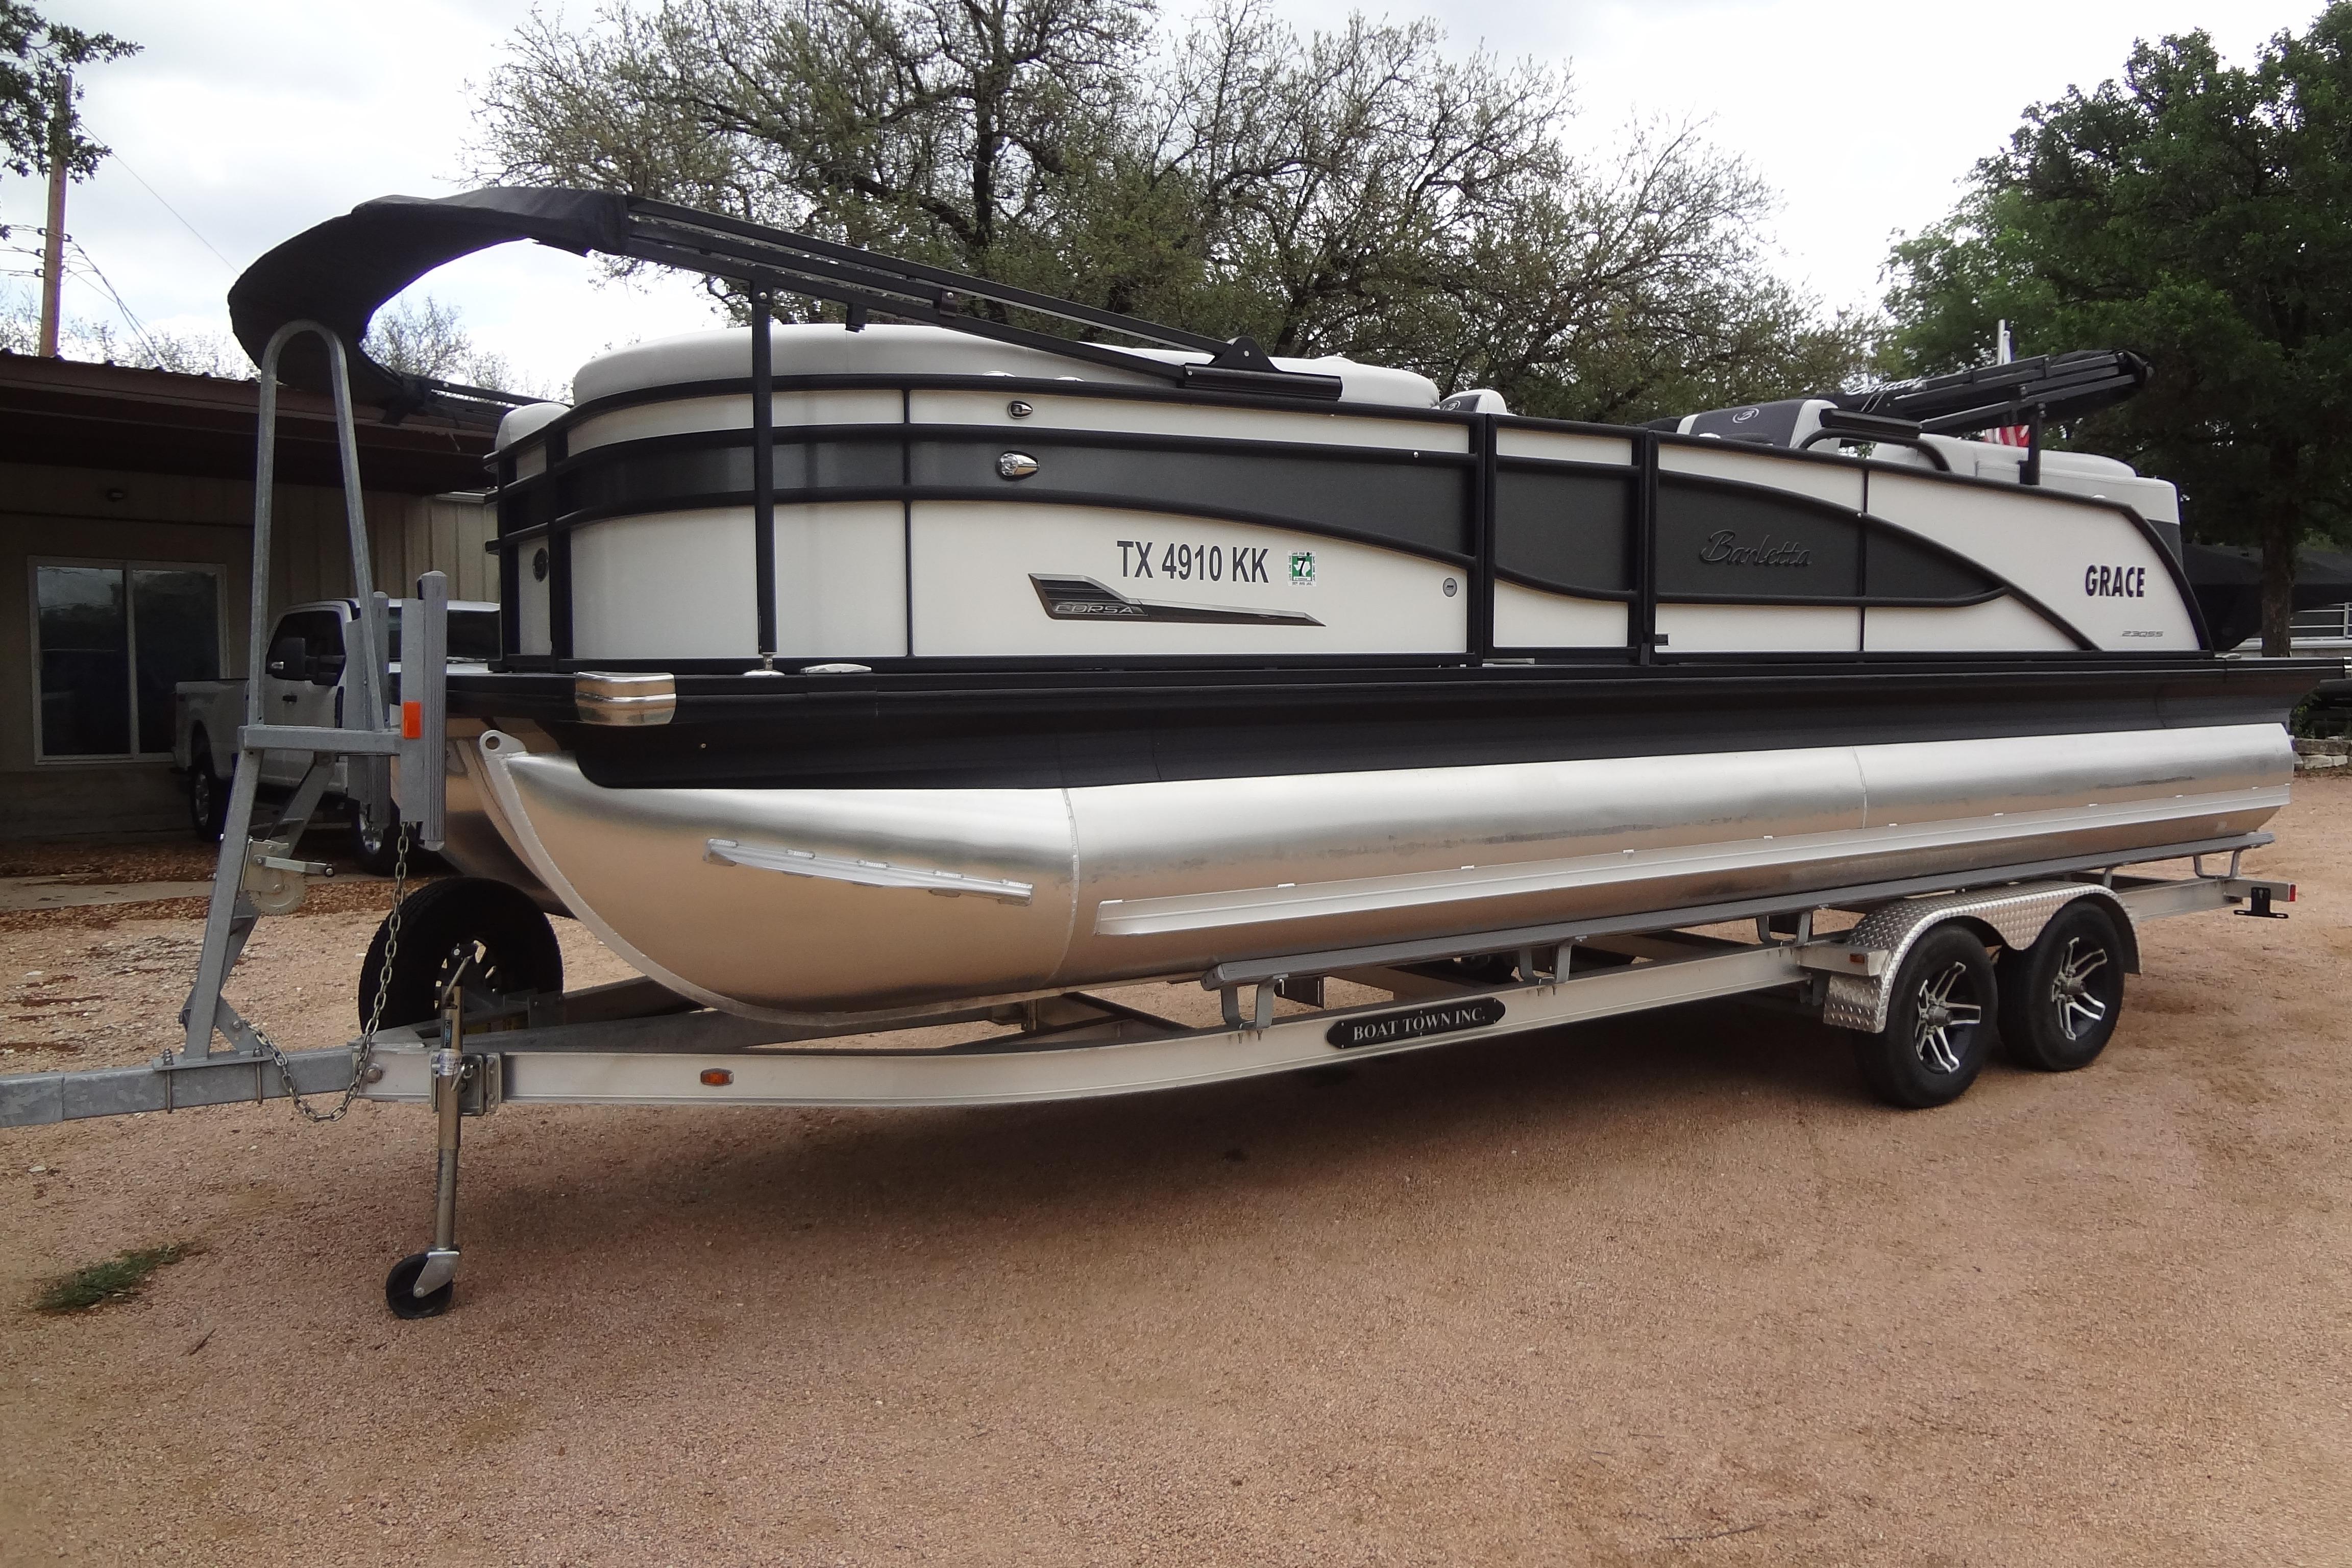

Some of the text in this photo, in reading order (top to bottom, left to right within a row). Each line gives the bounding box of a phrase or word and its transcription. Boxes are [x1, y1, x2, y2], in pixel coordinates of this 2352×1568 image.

[1117, 540, 1154, 579] TX
[1162, 543, 1221, 581] 4910
[1232, 547, 1270, 583] KK
[1699, 529, 1811, 565] Barletta
[1297, 557, 1306, 576] 7
[2085, 564, 2146, 597] GRACE
[1055, 604, 1134, 614] CORSA
[1353, 1007, 1486, 1041] BOAT TOWN INC.
